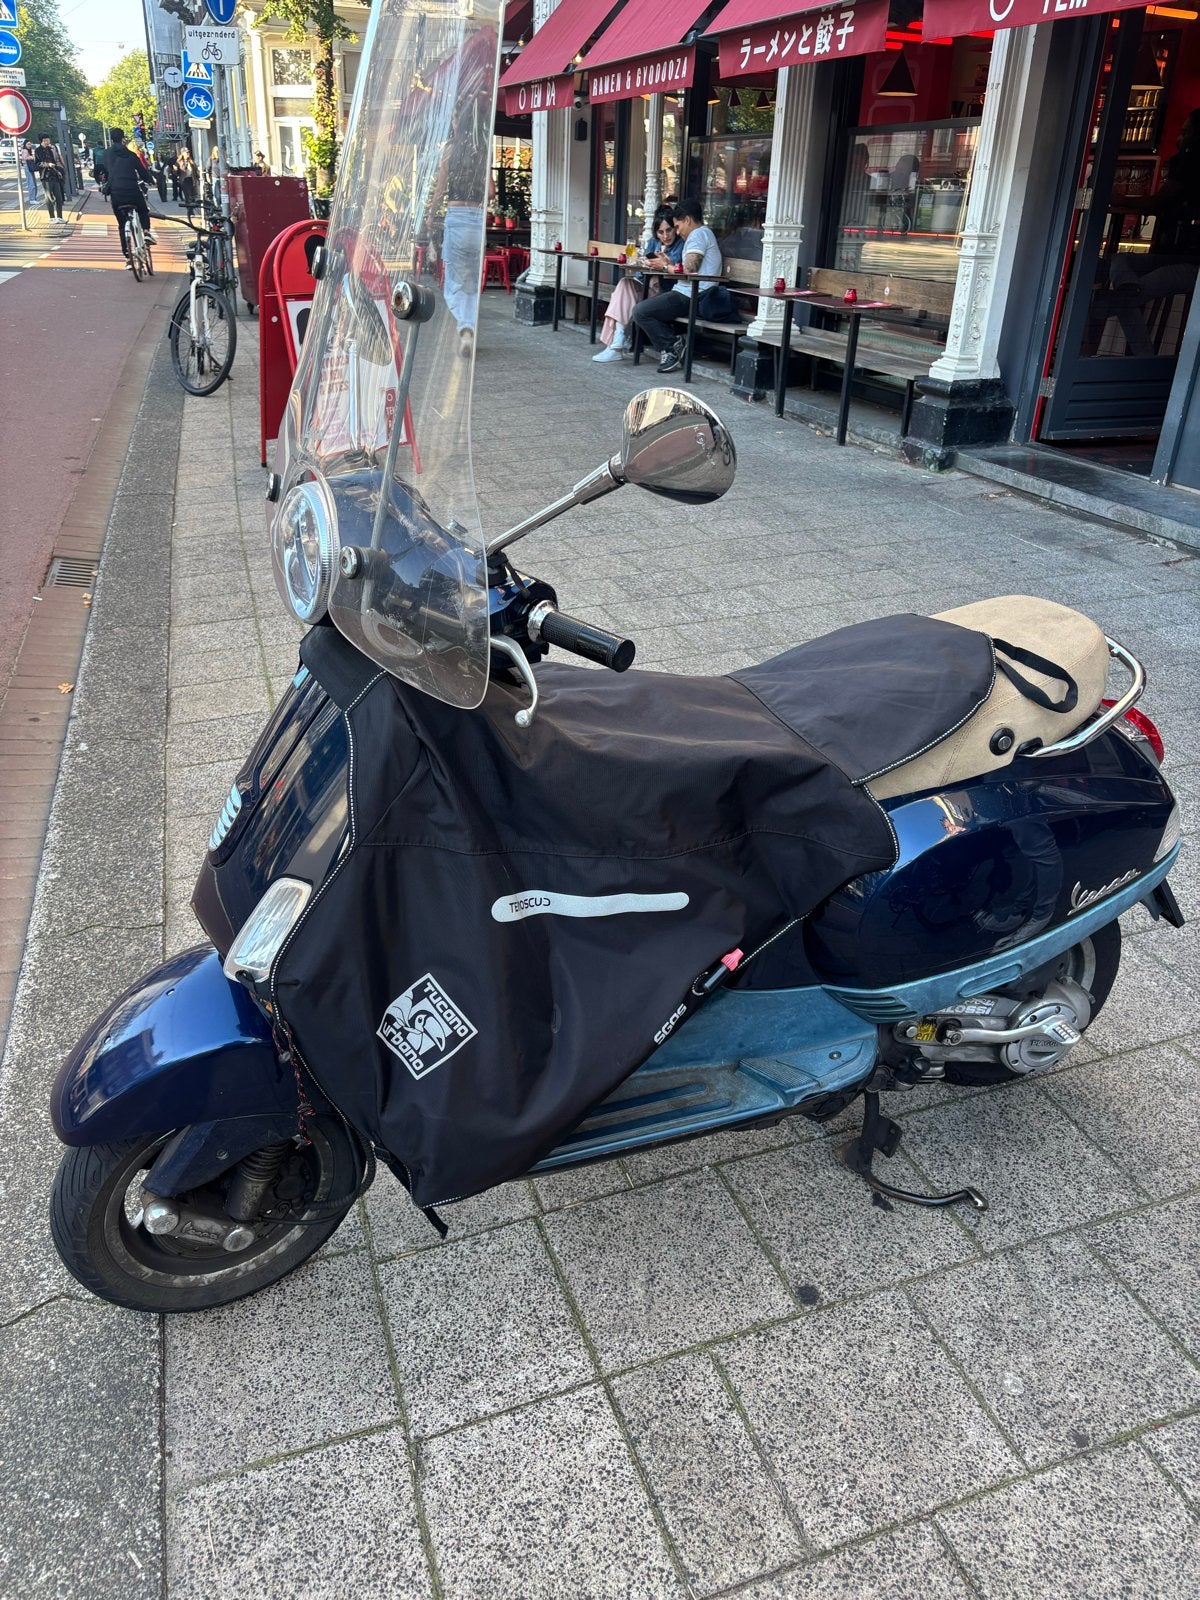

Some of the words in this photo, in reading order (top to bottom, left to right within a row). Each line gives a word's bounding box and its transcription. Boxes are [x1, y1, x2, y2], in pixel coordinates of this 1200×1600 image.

[740, 10, 855, 69] ラーメンと餃子
[592, 72, 622, 96] RAMEN
[625, 70, 632, 90] &
